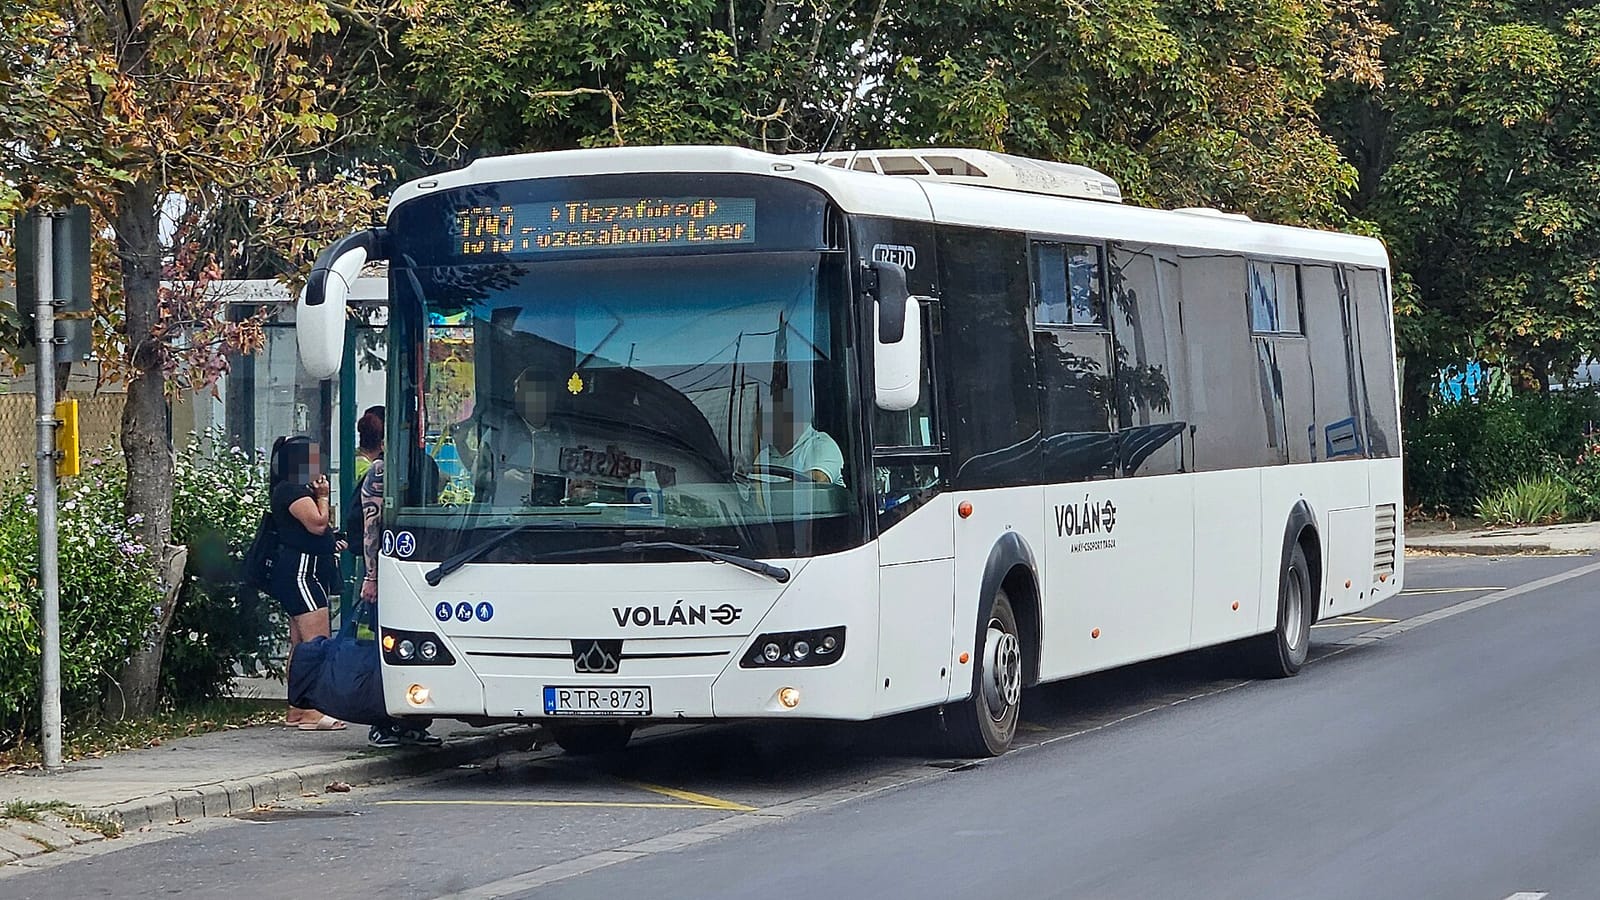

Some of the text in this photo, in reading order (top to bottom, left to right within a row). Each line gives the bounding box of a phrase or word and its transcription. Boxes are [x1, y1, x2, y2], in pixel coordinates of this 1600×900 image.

[565, 200, 705, 224] Tiszafüred
[1054, 493, 1101, 537] VOLÁN
[612, 599, 706, 628] VOLÁN
[559, 690, 645, 709] RTR-873
